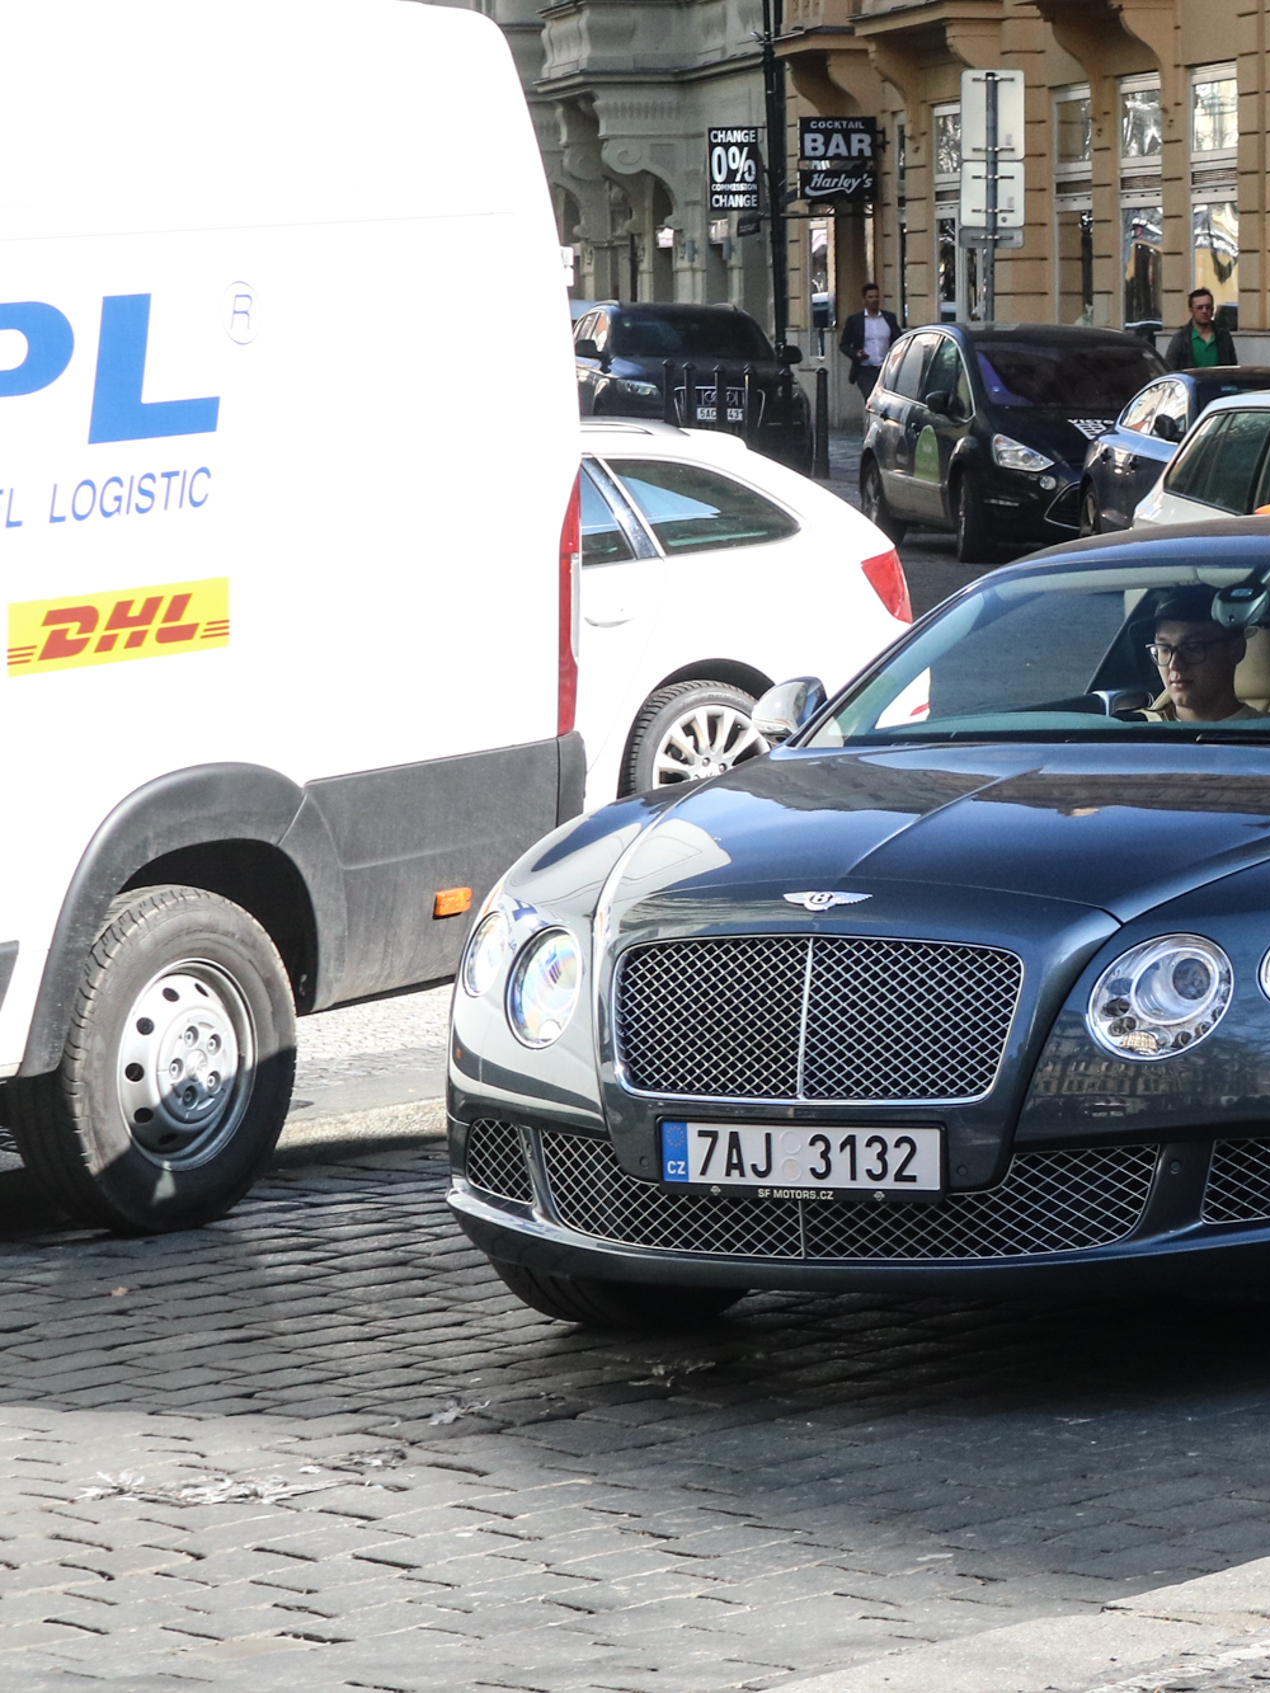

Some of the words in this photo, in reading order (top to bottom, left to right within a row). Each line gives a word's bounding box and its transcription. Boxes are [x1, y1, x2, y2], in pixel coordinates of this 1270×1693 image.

[710, 130, 757, 143] CHANGE
[810, 120, 865, 129] COCKTAIL
[803, 133, 873, 157] BAR
[711, 146, 757, 183] 0%
[804, 172, 873, 196] Harley's
[711, 194, 758, 208] CHANGE
[48, 466, 212, 524] LOGISTIC
[37, 592, 200, 662] DHL
[667, 1160, 686, 1175] CZ
[698, 1129, 773, 1178] 7AJ
[808, 1133, 918, 1183] 3132
[758, 1188, 770, 1198] SF
[773, 1189, 834, 1200] MOTORS.CZ
